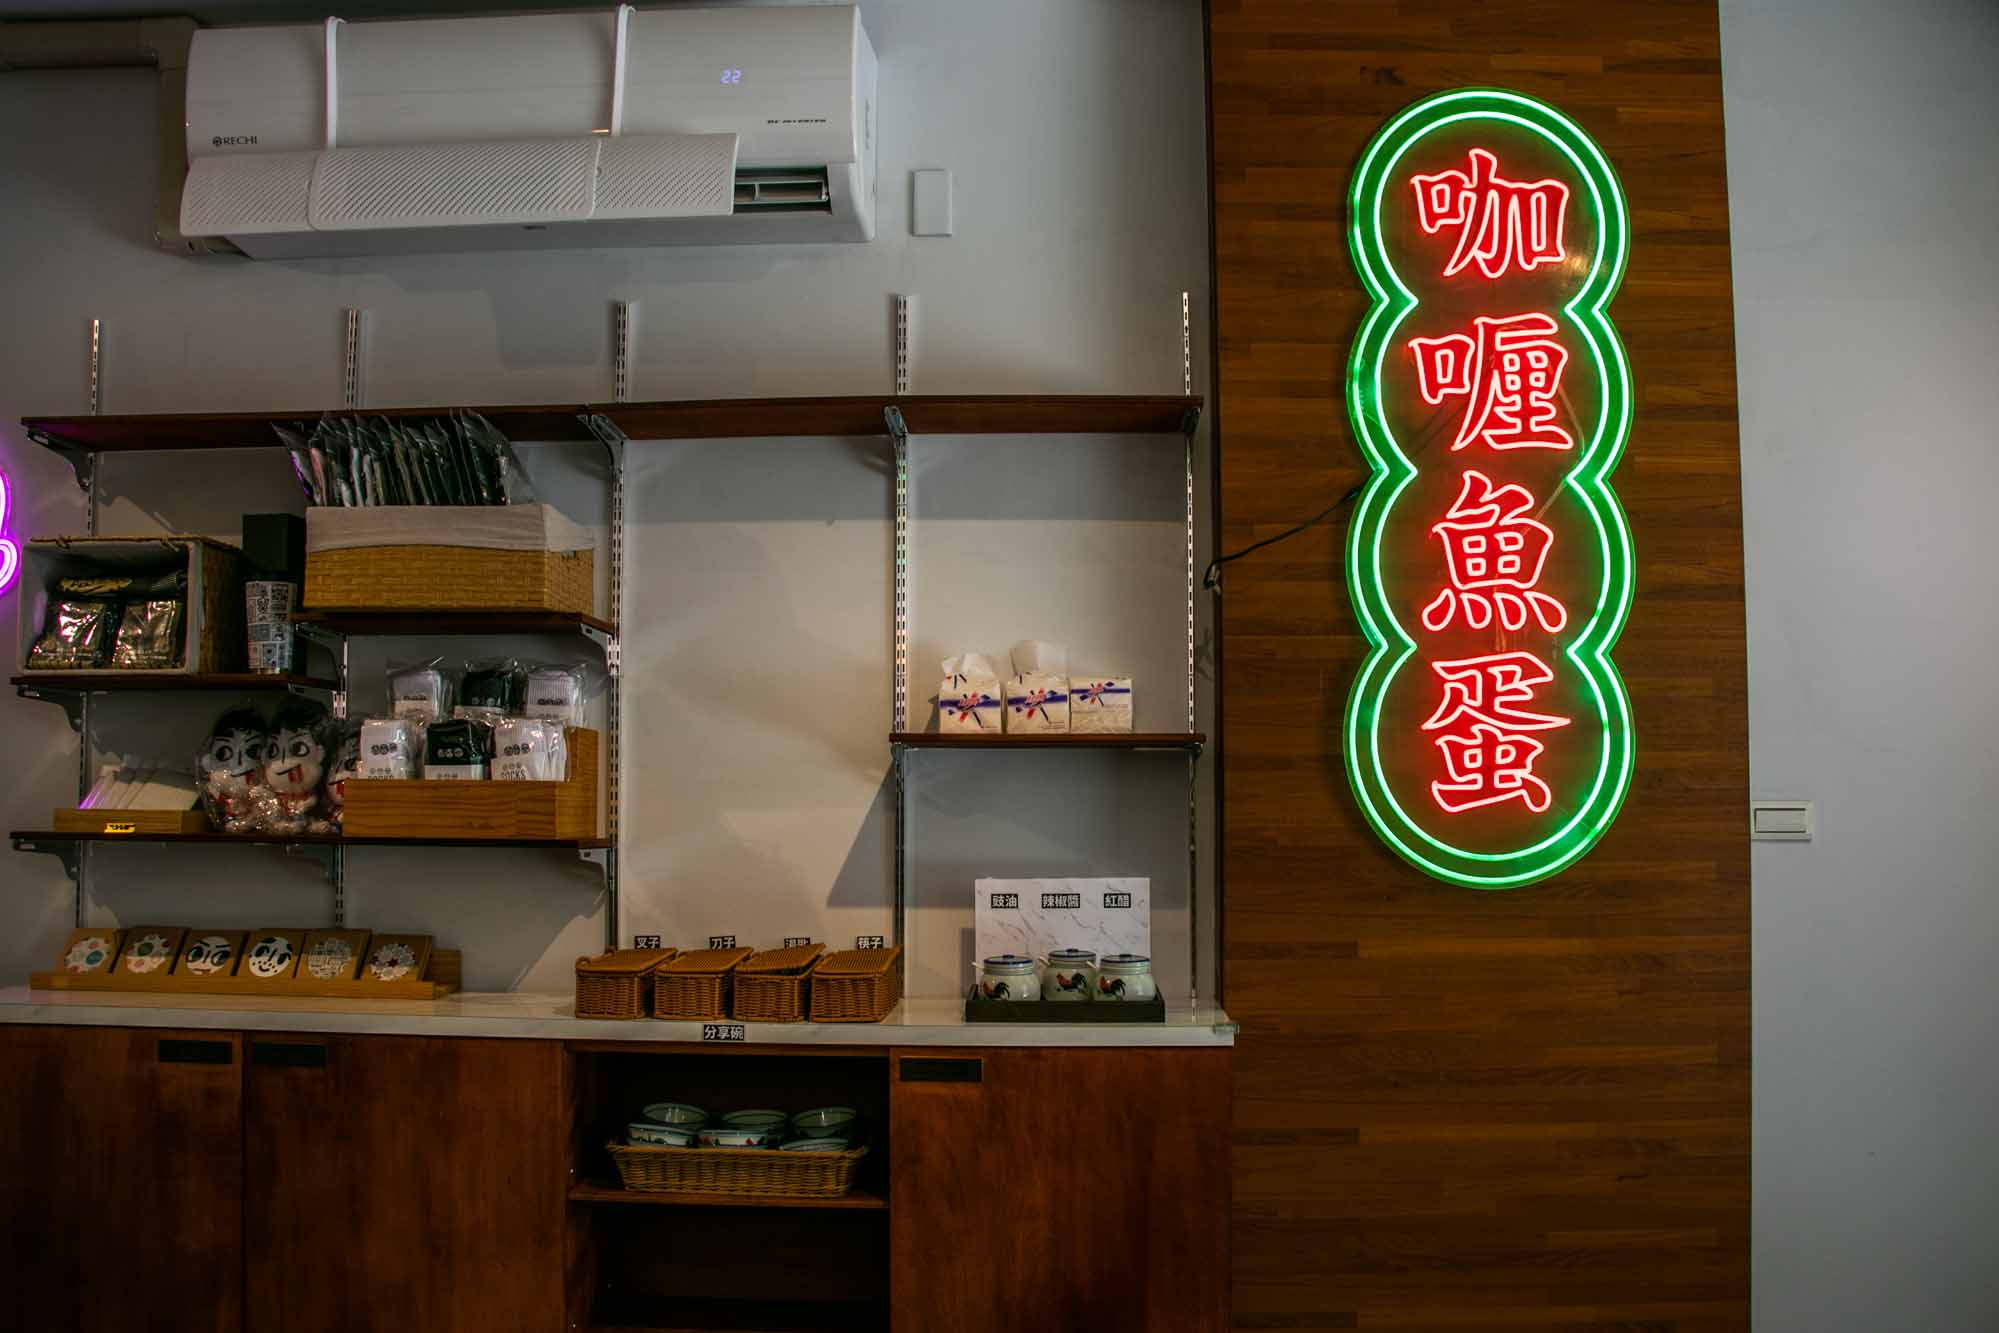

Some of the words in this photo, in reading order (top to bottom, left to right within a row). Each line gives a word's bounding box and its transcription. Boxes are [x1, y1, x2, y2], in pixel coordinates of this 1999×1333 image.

[720, 69, 742, 84] 22
[223, 135, 258, 145] RECHI
[1409, 147, 1575, 815] 咖喱魚蛋
[992, 895, 1018, 907] 豉油
[1105, 895, 1130, 907] 紅醋
[636, 937, 661, 949] 叉子
[711, 937, 736, 949] 刀子
[858, 937, 883, 949] 筷子
[704, 1025, 744, 1040] 分享碗
